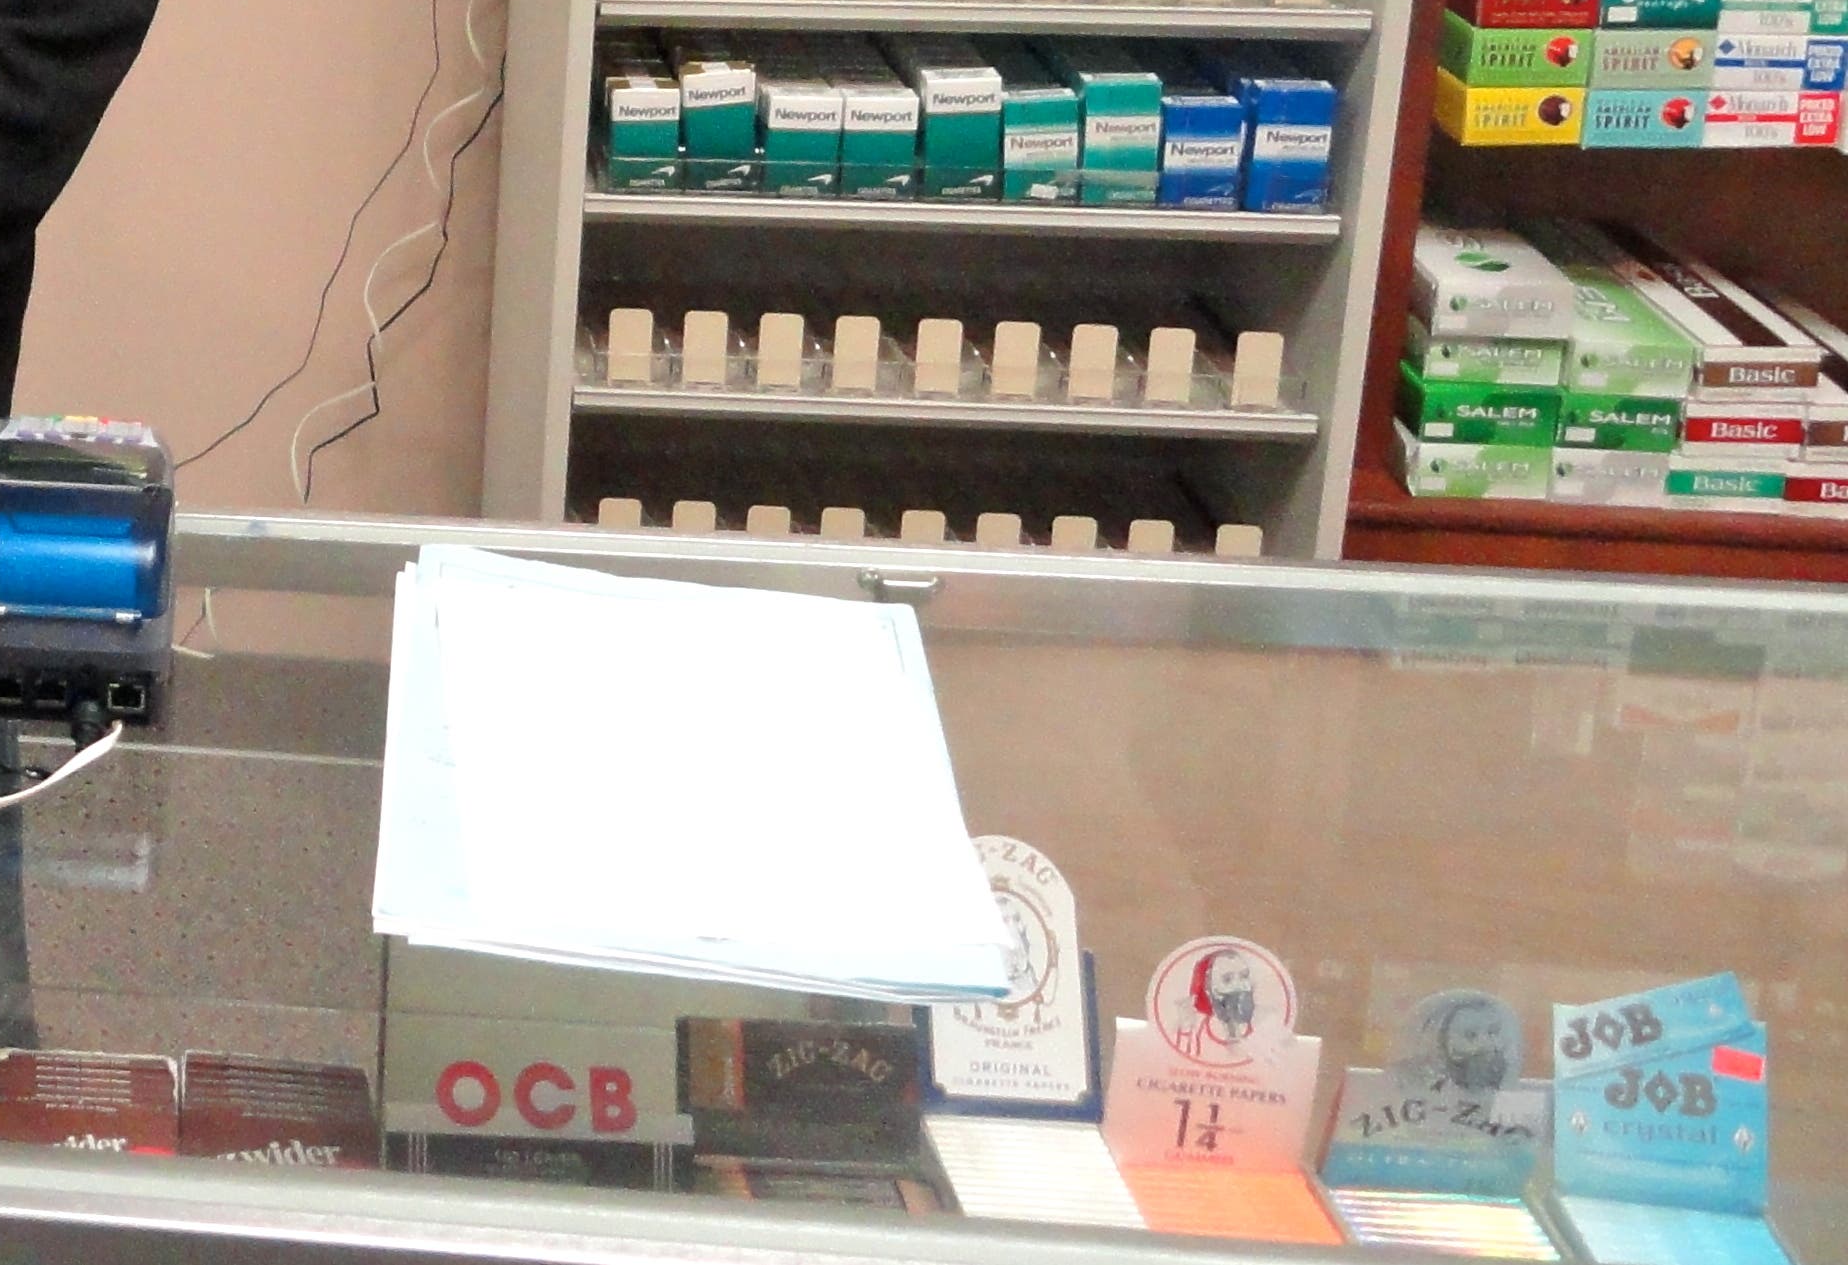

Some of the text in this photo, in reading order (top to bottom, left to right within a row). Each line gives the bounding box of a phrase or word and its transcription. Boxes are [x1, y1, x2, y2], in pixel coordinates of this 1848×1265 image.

[1480, 53, 1536, 68] SPIRIT
[1602, 55, 1660, 71] SPIRIT
[687, 86, 746, 103] Newport
[932, 92, 996, 107] Newport
[618, 104, 676, 118] Newport
[774, 107, 838, 123] Newport
[851, 108, 912, 123] Newport
[1094, 120, 1157, 135] Newport
[1474, 113, 1529, 128] SPIRIT
[1595, 114, 1650, 130] SPIRIT
[1009, 135, 1073, 151] Newport
[1266, 129, 1327, 146] Newport
[1170, 142, 1235, 158] Newport
[1728, 366, 1797, 385] Basic
[1456, 404, 1538, 420] SALEM
[1589, 410, 1672, 426] SALEM
[1710, 421, 1779, 440] Basic
[1692, 475, 1761, 493] Basic
[1560, 1003, 1663, 1059] JOB
[767, 1038, 894, 1084] ZIG-ZAG
[969, 1059, 1051, 1077] ORIGINAL
[436, 1060, 638, 1132] OCB
[1137, 1078, 1286, 1105] CIGARETTE PAPERS
[1604, 1065, 1717, 1118] JOB
